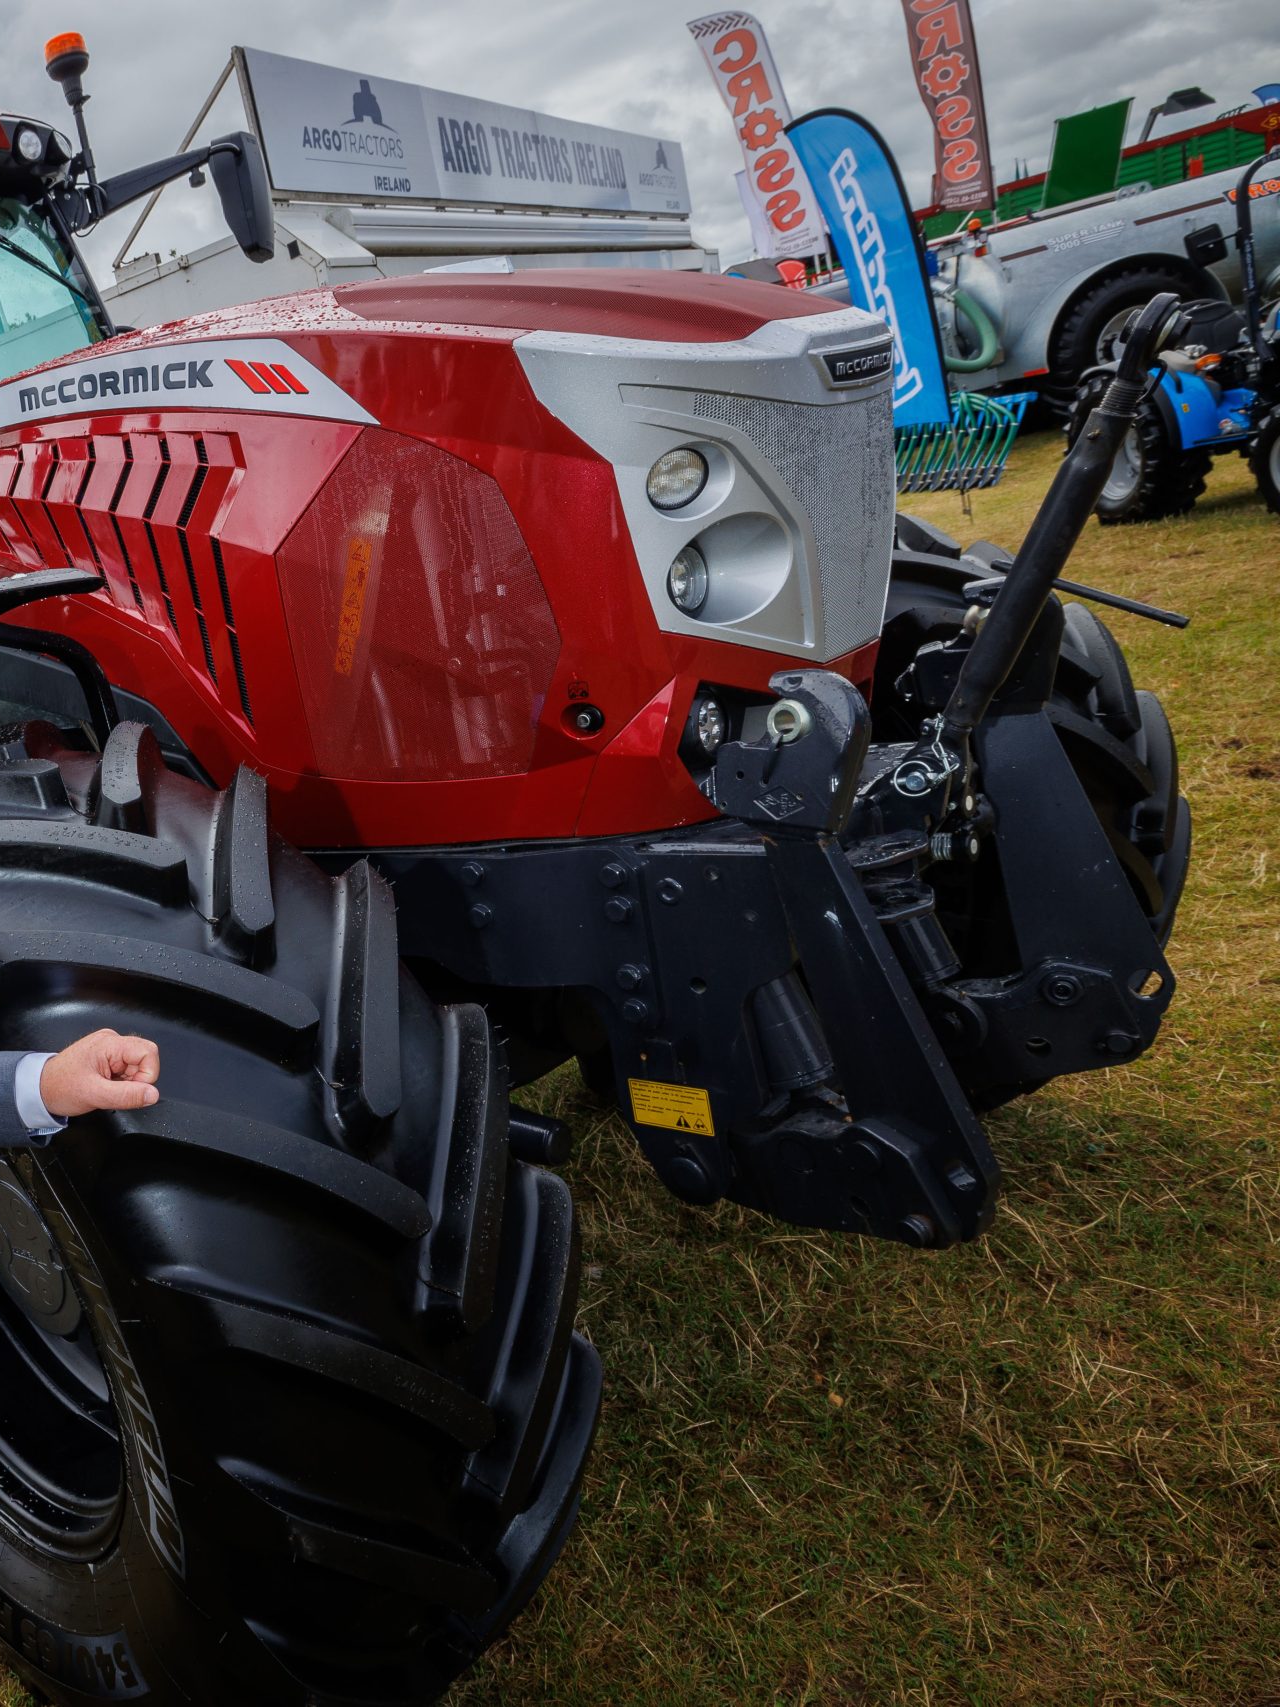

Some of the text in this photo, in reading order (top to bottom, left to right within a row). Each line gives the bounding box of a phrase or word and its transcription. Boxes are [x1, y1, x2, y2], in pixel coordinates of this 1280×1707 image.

[437, 116, 627, 190] ARGO TRACTORS IRELAND
[373, 175, 411, 193] IRELAND
[1047, 229, 1089, 246] SUPER
[1053, 239, 1080, 253] 2000
